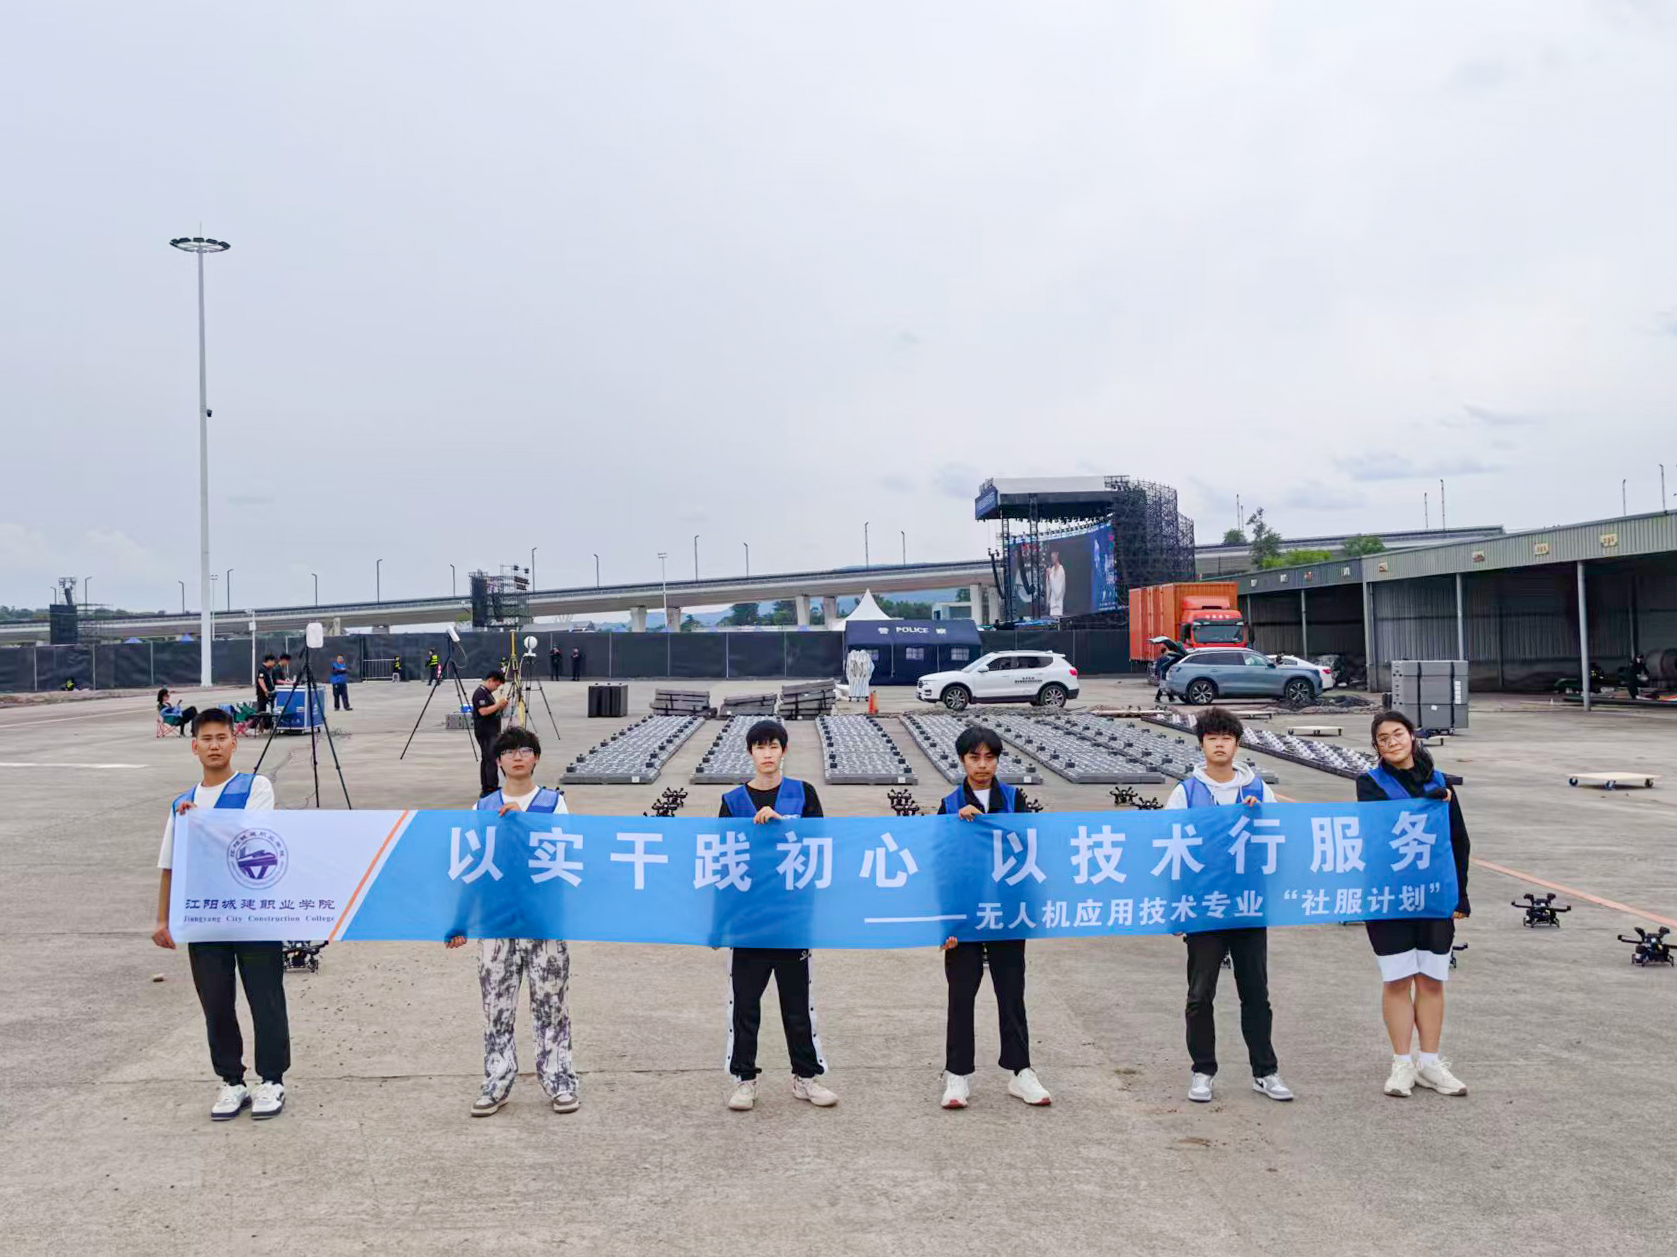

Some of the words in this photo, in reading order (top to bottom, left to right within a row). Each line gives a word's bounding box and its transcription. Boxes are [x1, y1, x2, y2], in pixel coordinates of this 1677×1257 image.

[896, 626, 929, 634] POLICE
[447, 826, 919, 891] 以实干践初心
[991, 811, 1438, 887] 以技术行服务
[185, 899, 335, 910] 江阳城建职业学院
[976, 890, 1264, 930] 无人机应用技术专业
